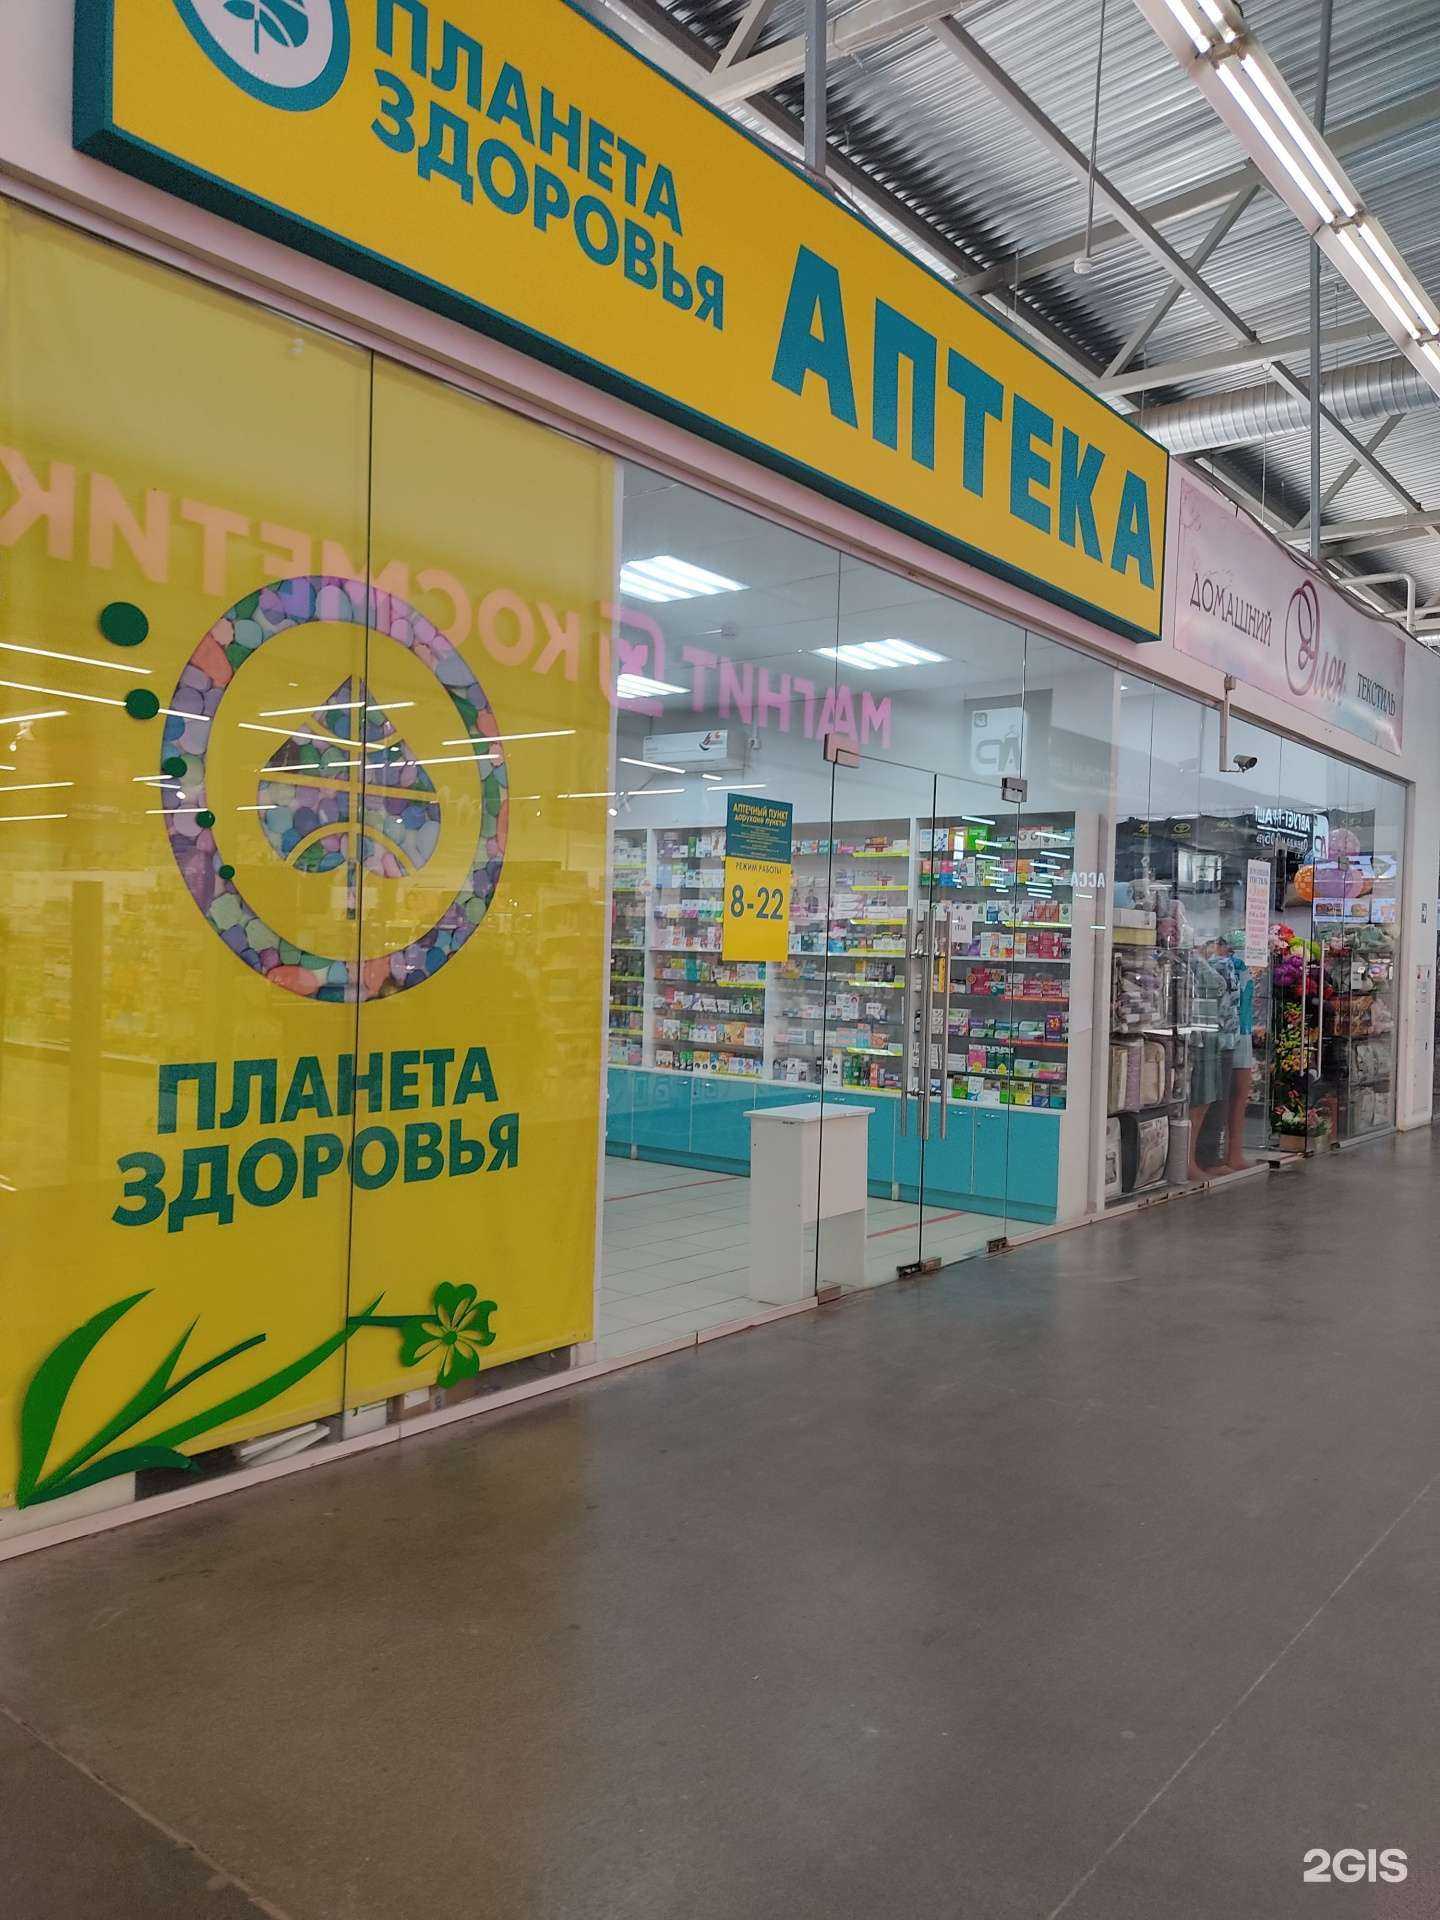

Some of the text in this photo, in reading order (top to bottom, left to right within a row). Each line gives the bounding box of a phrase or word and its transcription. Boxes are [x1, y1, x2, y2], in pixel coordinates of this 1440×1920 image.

[376, 0, 683, 237] ПЛАНЕТА
[371, 69, 724, 331] ЗДОРОВЬЯ
[771, 244, 1155, 591] АПТЕКА
[1189, 573, 1272, 647] ДОМАШНИЙ
[1357, 672, 1396, 716] ТЕКСТИЛЬ
[732, 803, 789, 821] АПТЕЧНЫЙ ПУНКТ
[730, 884, 784, 920] 8-22
[735, 862, 782, 875] РЕЖИМ РАБОТЫ
[157, 1047, 498, 1134] ПЛАНЕТА
[112, 1113, 519, 1233] ЗДОРОВЬЯ
